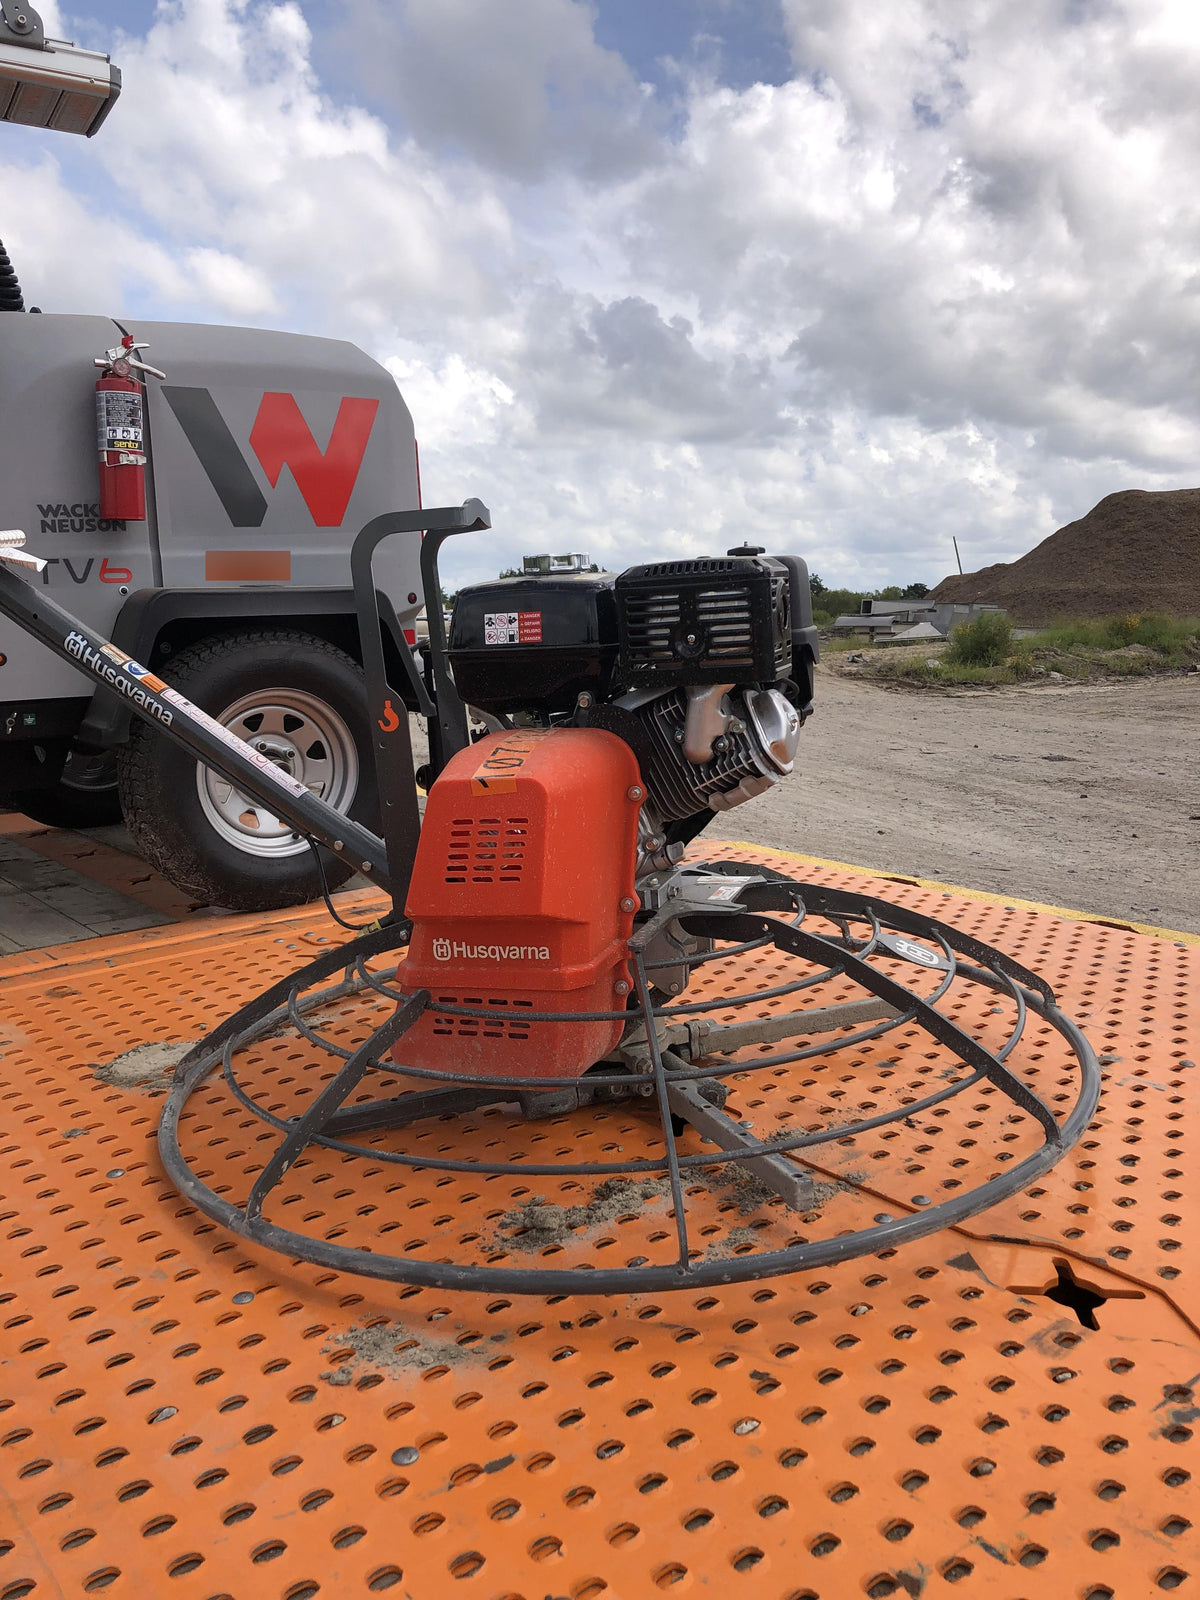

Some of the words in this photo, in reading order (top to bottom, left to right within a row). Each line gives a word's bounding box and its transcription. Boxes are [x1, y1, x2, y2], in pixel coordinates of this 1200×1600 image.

[37, 503, 101, 518] WACK
[40, 519, 127, 533] NEUSON
[42, 557, 133, 585] TV6
[82, 646, 174, 727] Husqvarna
[452, 941, 551, 962] Husqvarna
